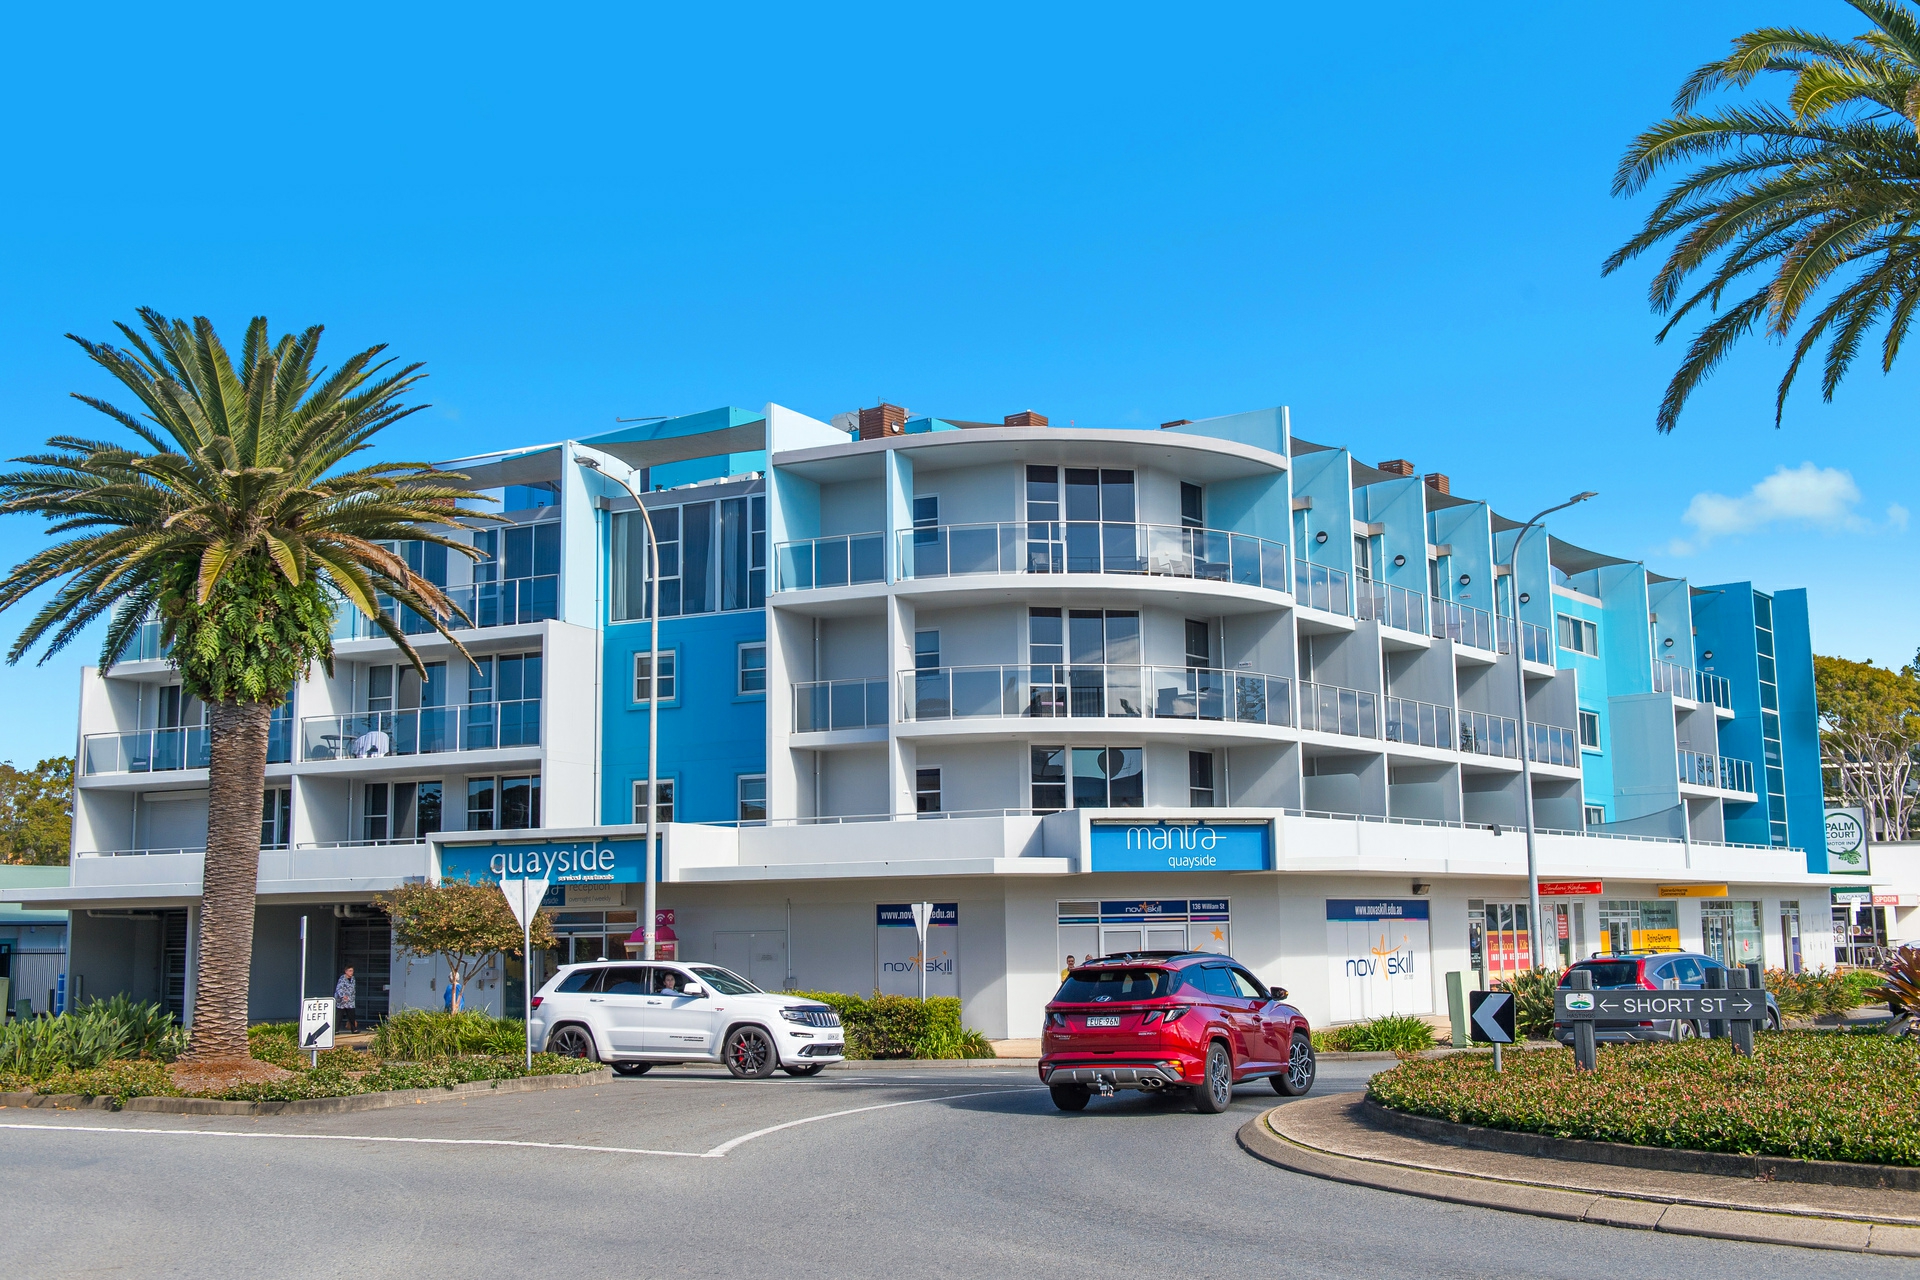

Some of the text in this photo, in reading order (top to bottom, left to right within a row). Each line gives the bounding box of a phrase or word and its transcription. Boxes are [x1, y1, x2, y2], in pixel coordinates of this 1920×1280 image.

[1825, 822, 1854, 831] PALM
[1127, 824, 1227, 850] mantra
[1826, 831, 1855, 839] COURT
[490, 842, 615, 880] quayside
[1168, 854, 1217, 868] quayside
[569, 883, 611, 894] reception
[881, 908, 955, 919] www.nova.edu.au
[307, 1002, 329, 1011] KEEP
[1623, 998, 1726, 1013] SHORT ST
[306, 1012, 327, 1021] LEFT
